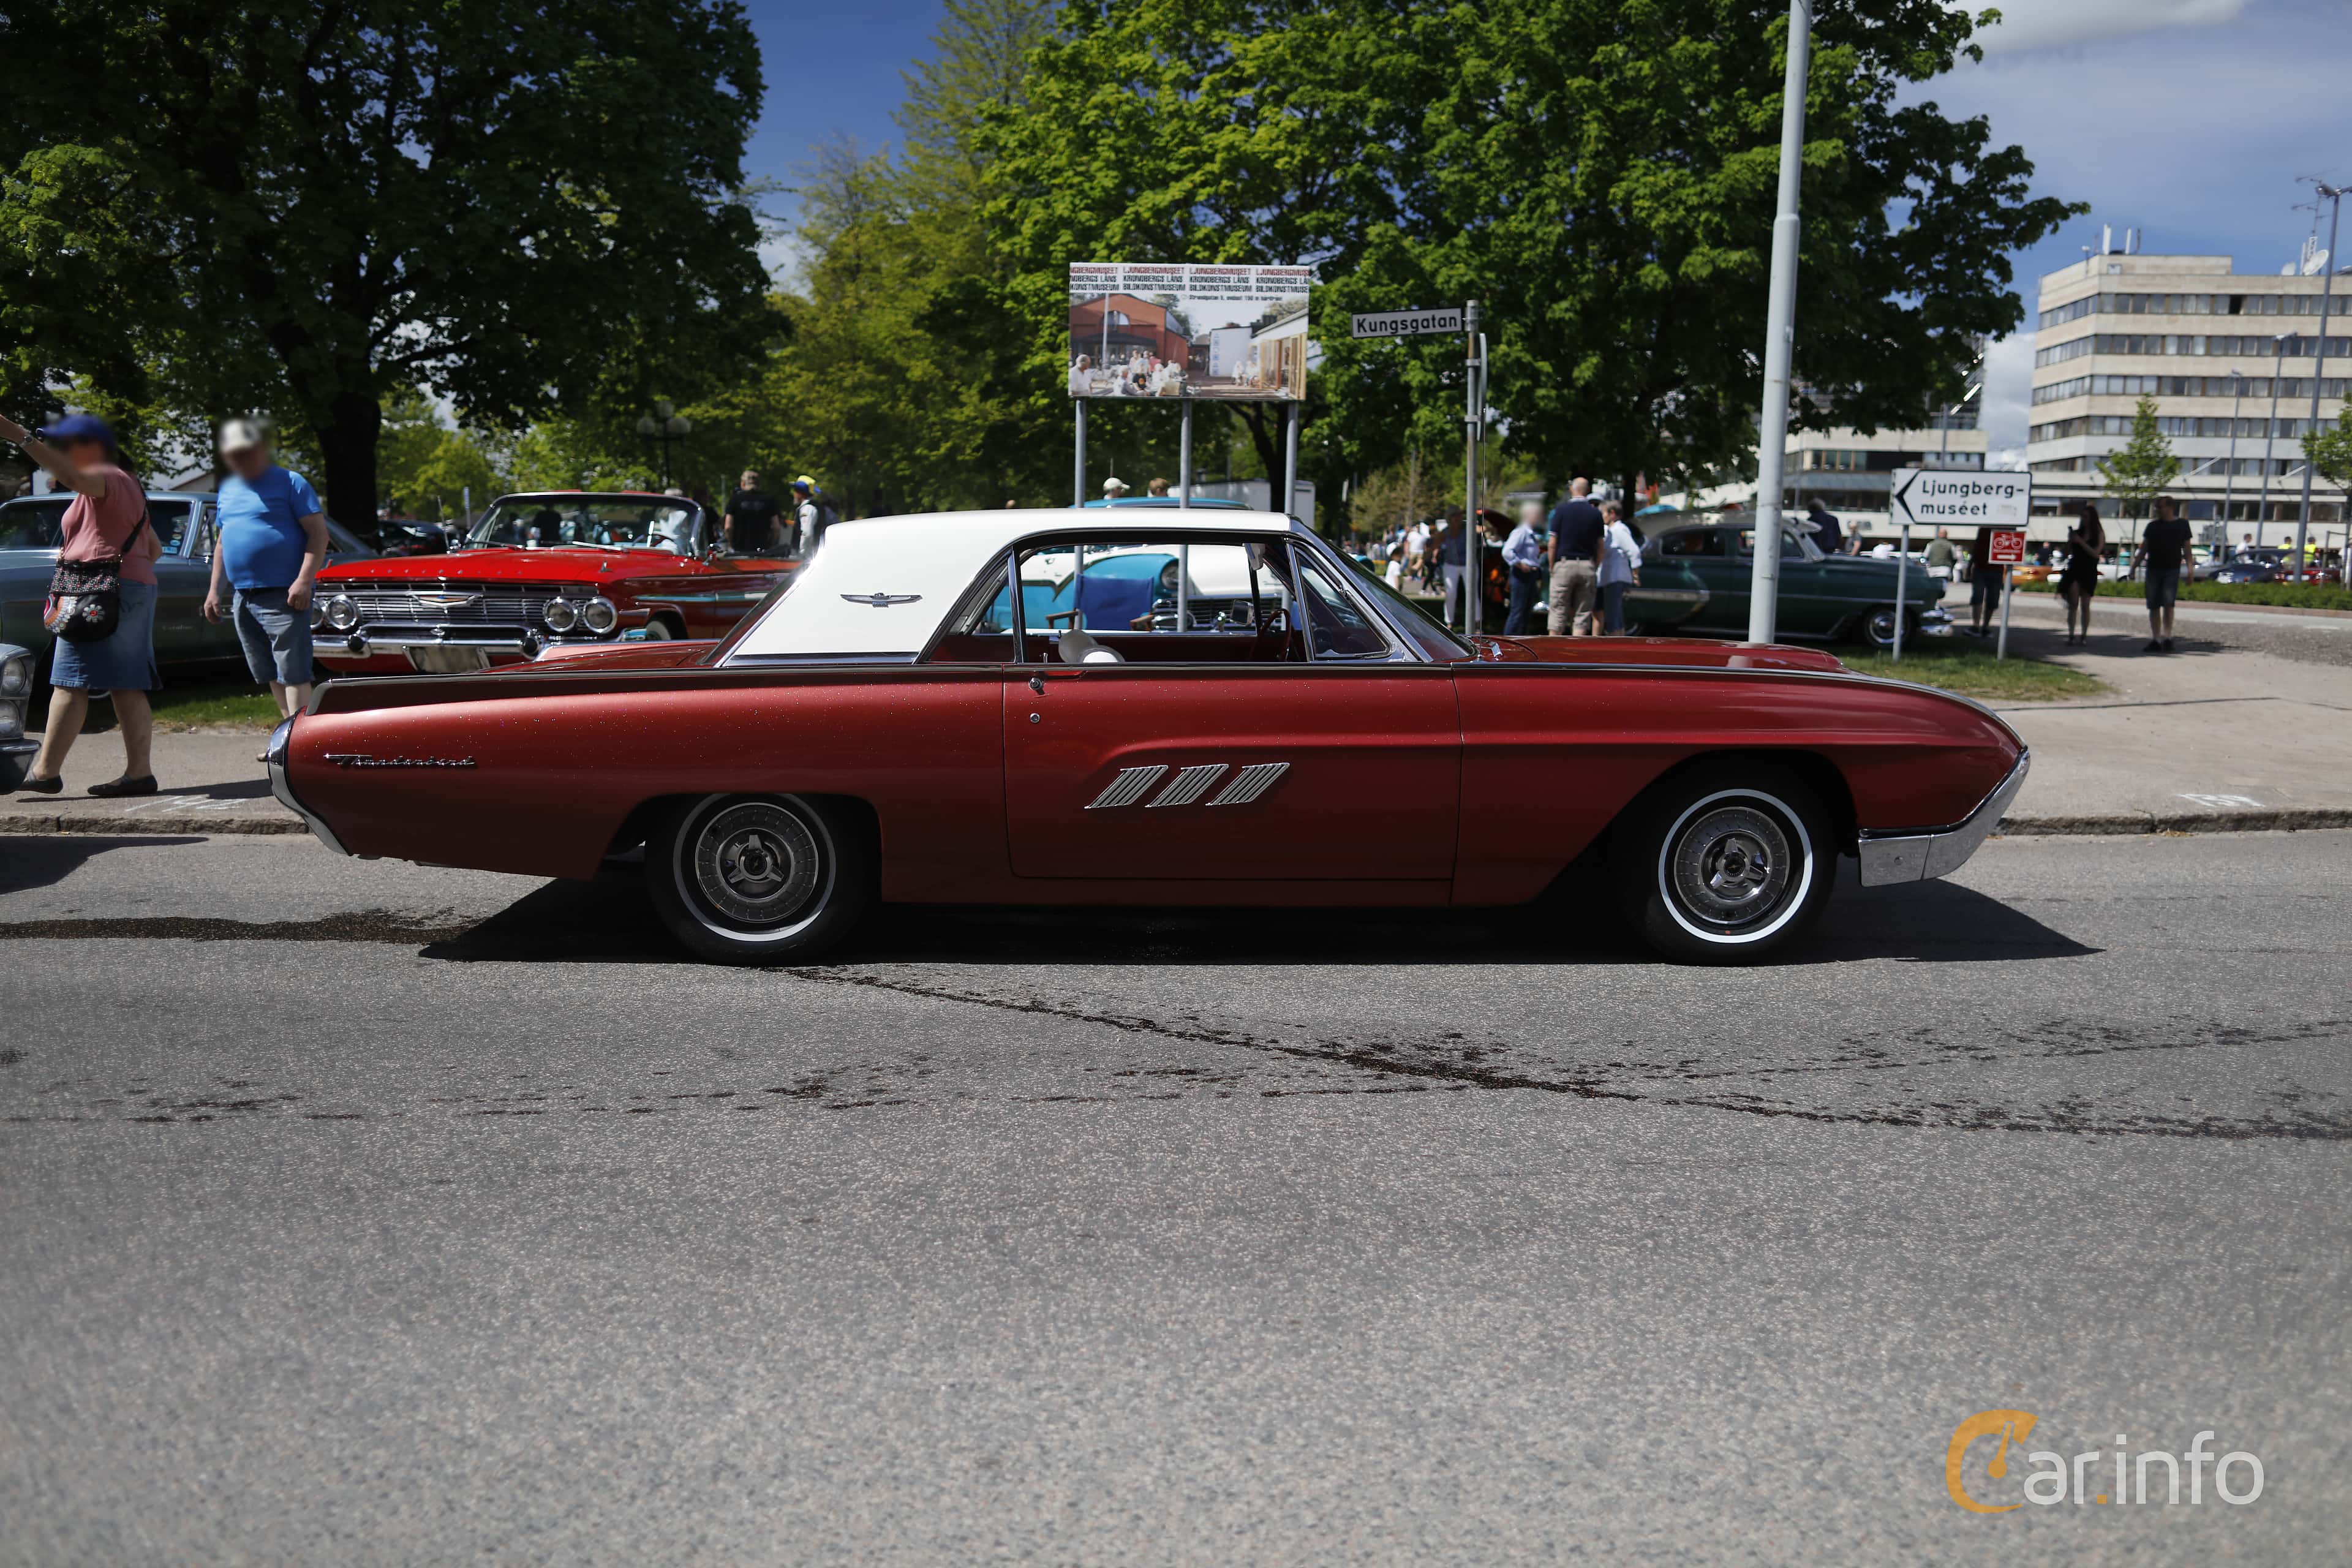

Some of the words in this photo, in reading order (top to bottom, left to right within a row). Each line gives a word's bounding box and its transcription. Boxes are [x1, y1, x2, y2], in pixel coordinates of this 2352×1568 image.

[1357, 315, 1457, 334] Kungsgatan
[1922, 480, 2024, 499] Ljungberg-
[1921, 500, 1987, 515] muséet
